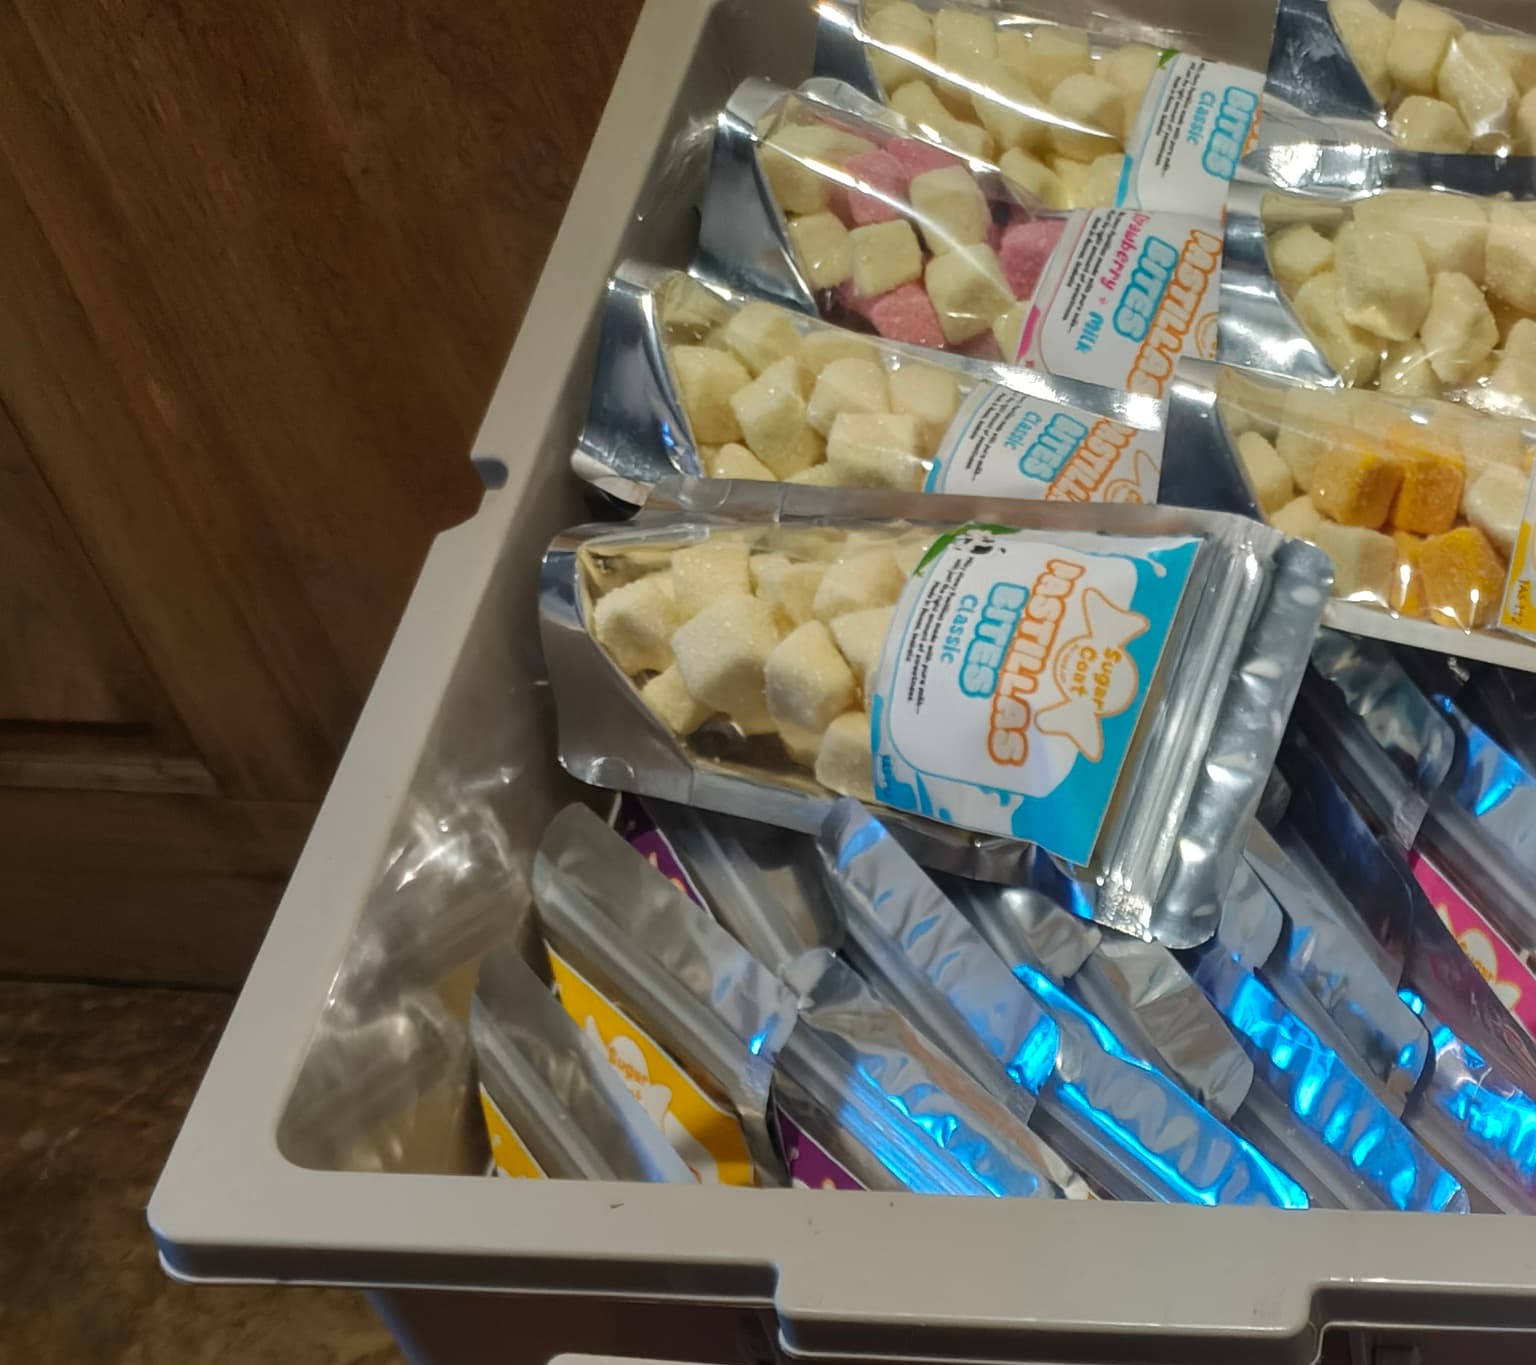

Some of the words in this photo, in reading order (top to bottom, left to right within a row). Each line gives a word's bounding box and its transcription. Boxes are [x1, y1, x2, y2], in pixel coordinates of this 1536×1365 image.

[1187, 91, 1216, 145] Classic
[1201, 86, 1259, 181] BITES
[1112, 236, 1179, 342] BITES
[1074, 311, 1105, 354] Milk
[1004, 410, 1043, 450] Classic
[1018, 412, 1089, 483] BITES
[940, 594, 978, 664] Classic
[959, 582, 1030, 698] BITES
[986, 559, 1086, 767] PASTILLAS
[1071, 646, 1096, 697] Coat
[1095, 647, 1122, 711] Sugar
